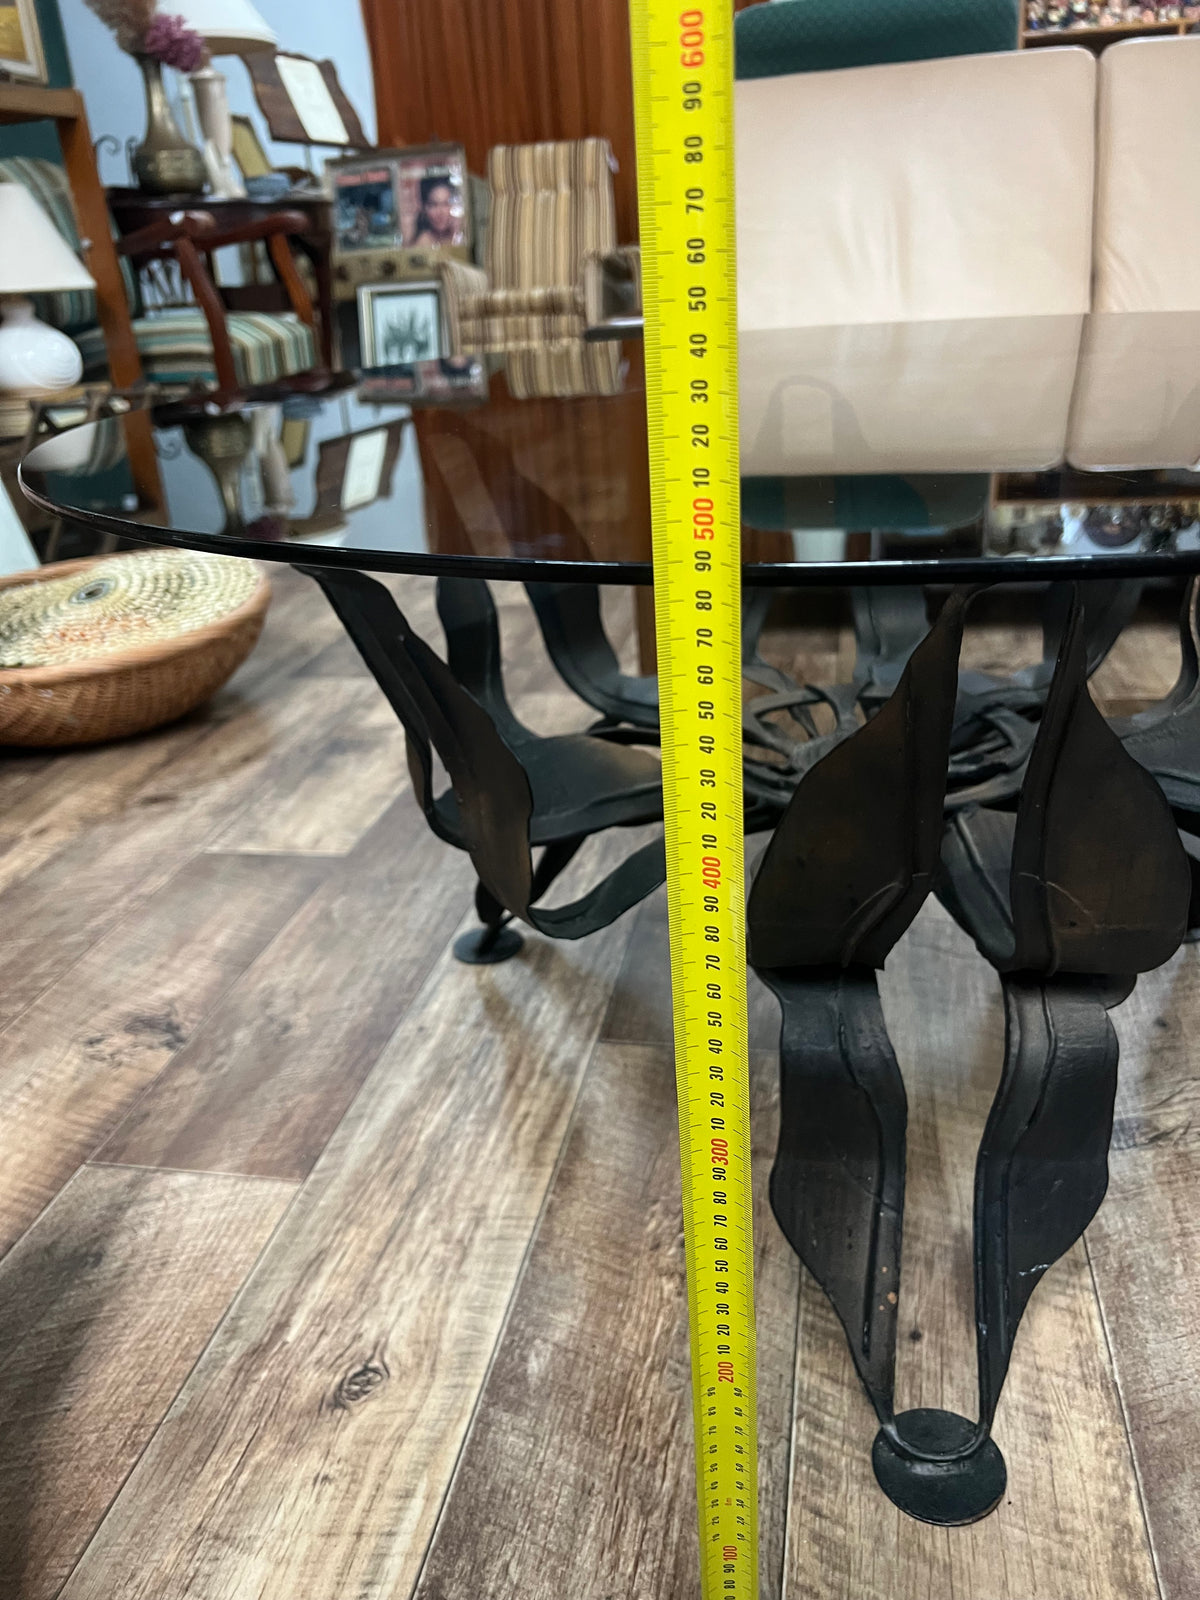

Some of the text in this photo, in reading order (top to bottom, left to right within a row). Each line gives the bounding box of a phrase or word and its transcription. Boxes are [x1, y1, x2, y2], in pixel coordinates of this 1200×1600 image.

[680, 9, 705, 69] 600
[683, 82, 702, 110] 90
[684, 135, 704, 164] 80
[685, 188, 705, 214] 70
[687, 237, 705, 264] 60
[688, 286, 707, 312] 50
[689, 333, 708, 358] 40
[691, 379, 708, 403] 30
[692, 423, 710, 448] 20
[693, 467, 710, 488] 10
[693, 497, 715, 541] 500
[695, 550, 712, 572] 90
[696, 590, 712, 611] 80
[697, 628, 713, 648] 70
[697, 665, 714, 685] 60
[698, 700, 715, 720] 50
[700, 735, 715, 754] 40
[700, 769, 716, 788] 30
[701, 801, 717, 821] 20
[702, 834, 718, 850] 10
[702, 856, 722, 889] 400
[704, 895, 719, 913] 90
[705, 925, 720, 943] 80
[705, 954, 721, 970] 70
[707, 983, 722, 1000] 60
[707, 1011, 723, 1028] 50
[708, 1038, 723, 1054] 40
[710, 1065, 724, 1081] 30
[710, 1092, 725, 1108] 20
[711, 1117, 725, 1131] 10
[711, 1138, 729, 1166] 300
[713, 1167, 727, 1181] 90
[713, 1190, 728, 1205] 80
[714, 1214, 728, 1227] 70
[715, 1237, 728, 1251] 60
[715, 1259, 729, 1273] 50
[715, 1281, 729, 1295] 40
[716, 1303, 730, 1315] 30
[716, 1324, 730, 1337] 20
[717, 1344, 730, 1354] 10
[718, 1361, 734, 1383] 200
[722, 1545, 737, 1561] 100
[723, 1564, 735, 1573] 90
[723, 1579, 735, 1589] 80
